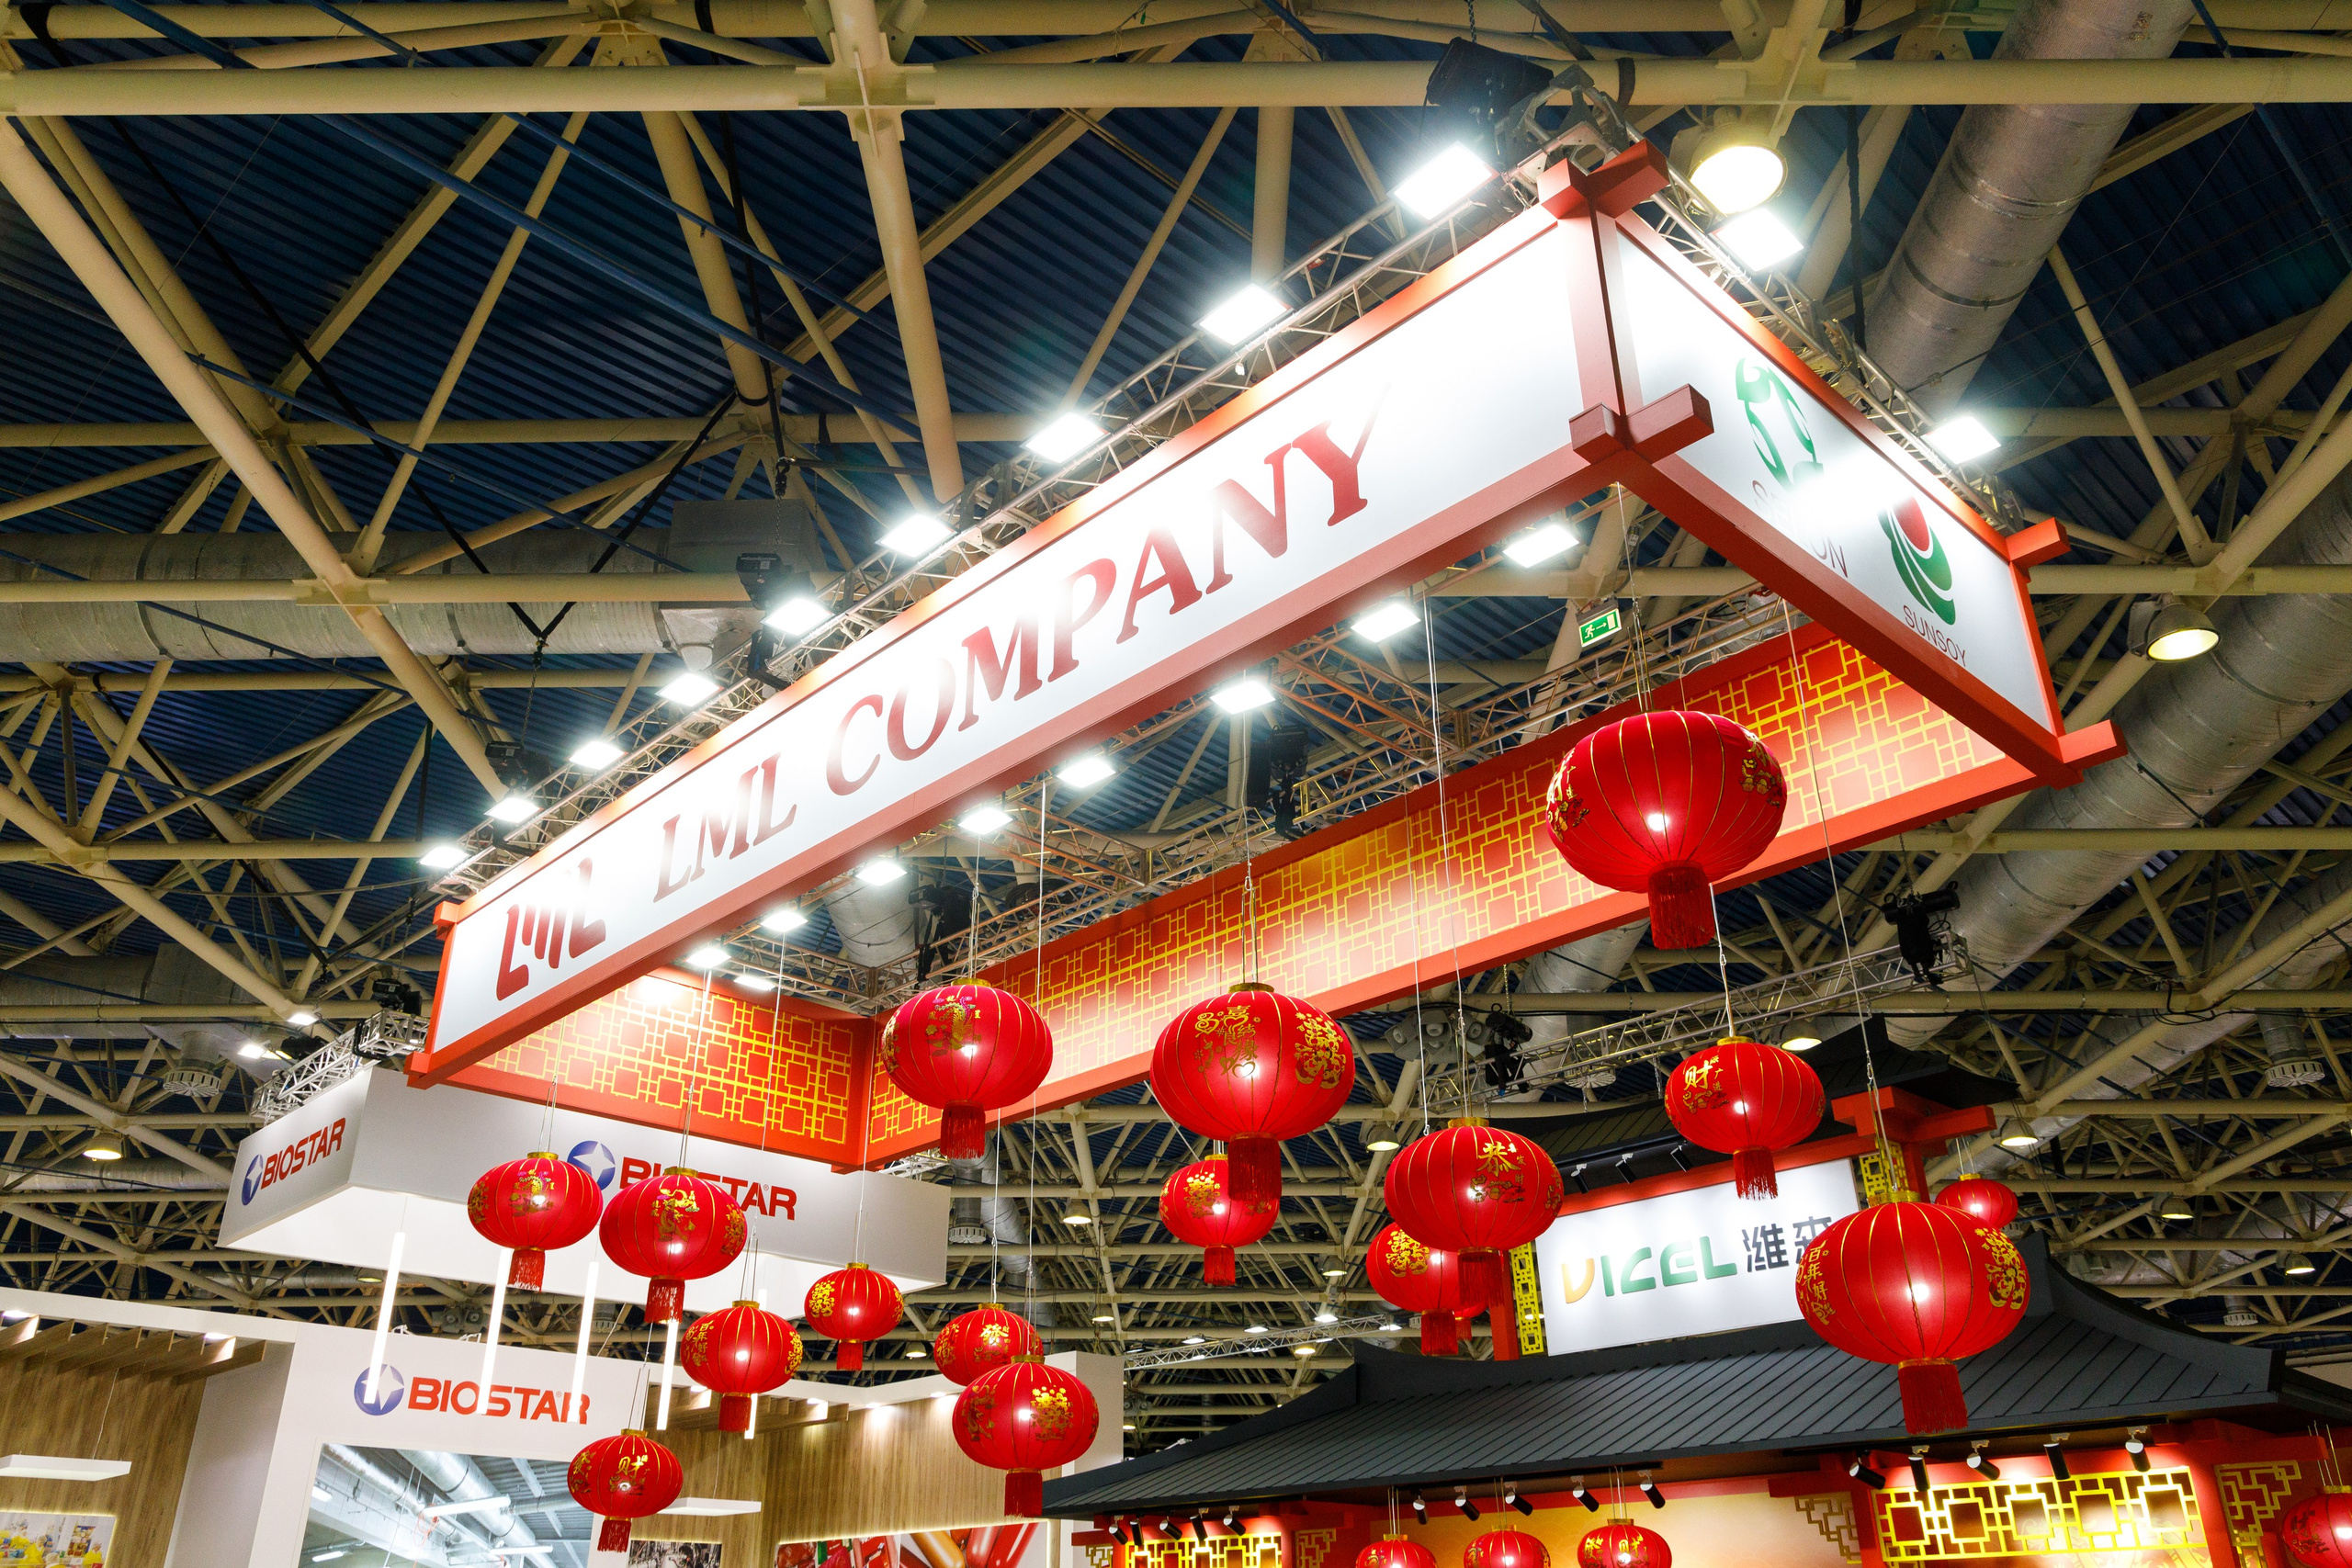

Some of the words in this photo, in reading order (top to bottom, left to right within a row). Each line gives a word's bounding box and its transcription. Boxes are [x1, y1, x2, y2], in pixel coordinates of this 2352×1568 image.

[652, 751, 797, 903] LML
[826, 382, 1391, 796] COMPANY
[1903, 604, 1966, 668] SUNSOY
[261, 1117, 346, 1190] BIOSTAR
[619, 1156, 797, 1221] BTAR
[408, 1376, 591, 1425] BIOSTAR
